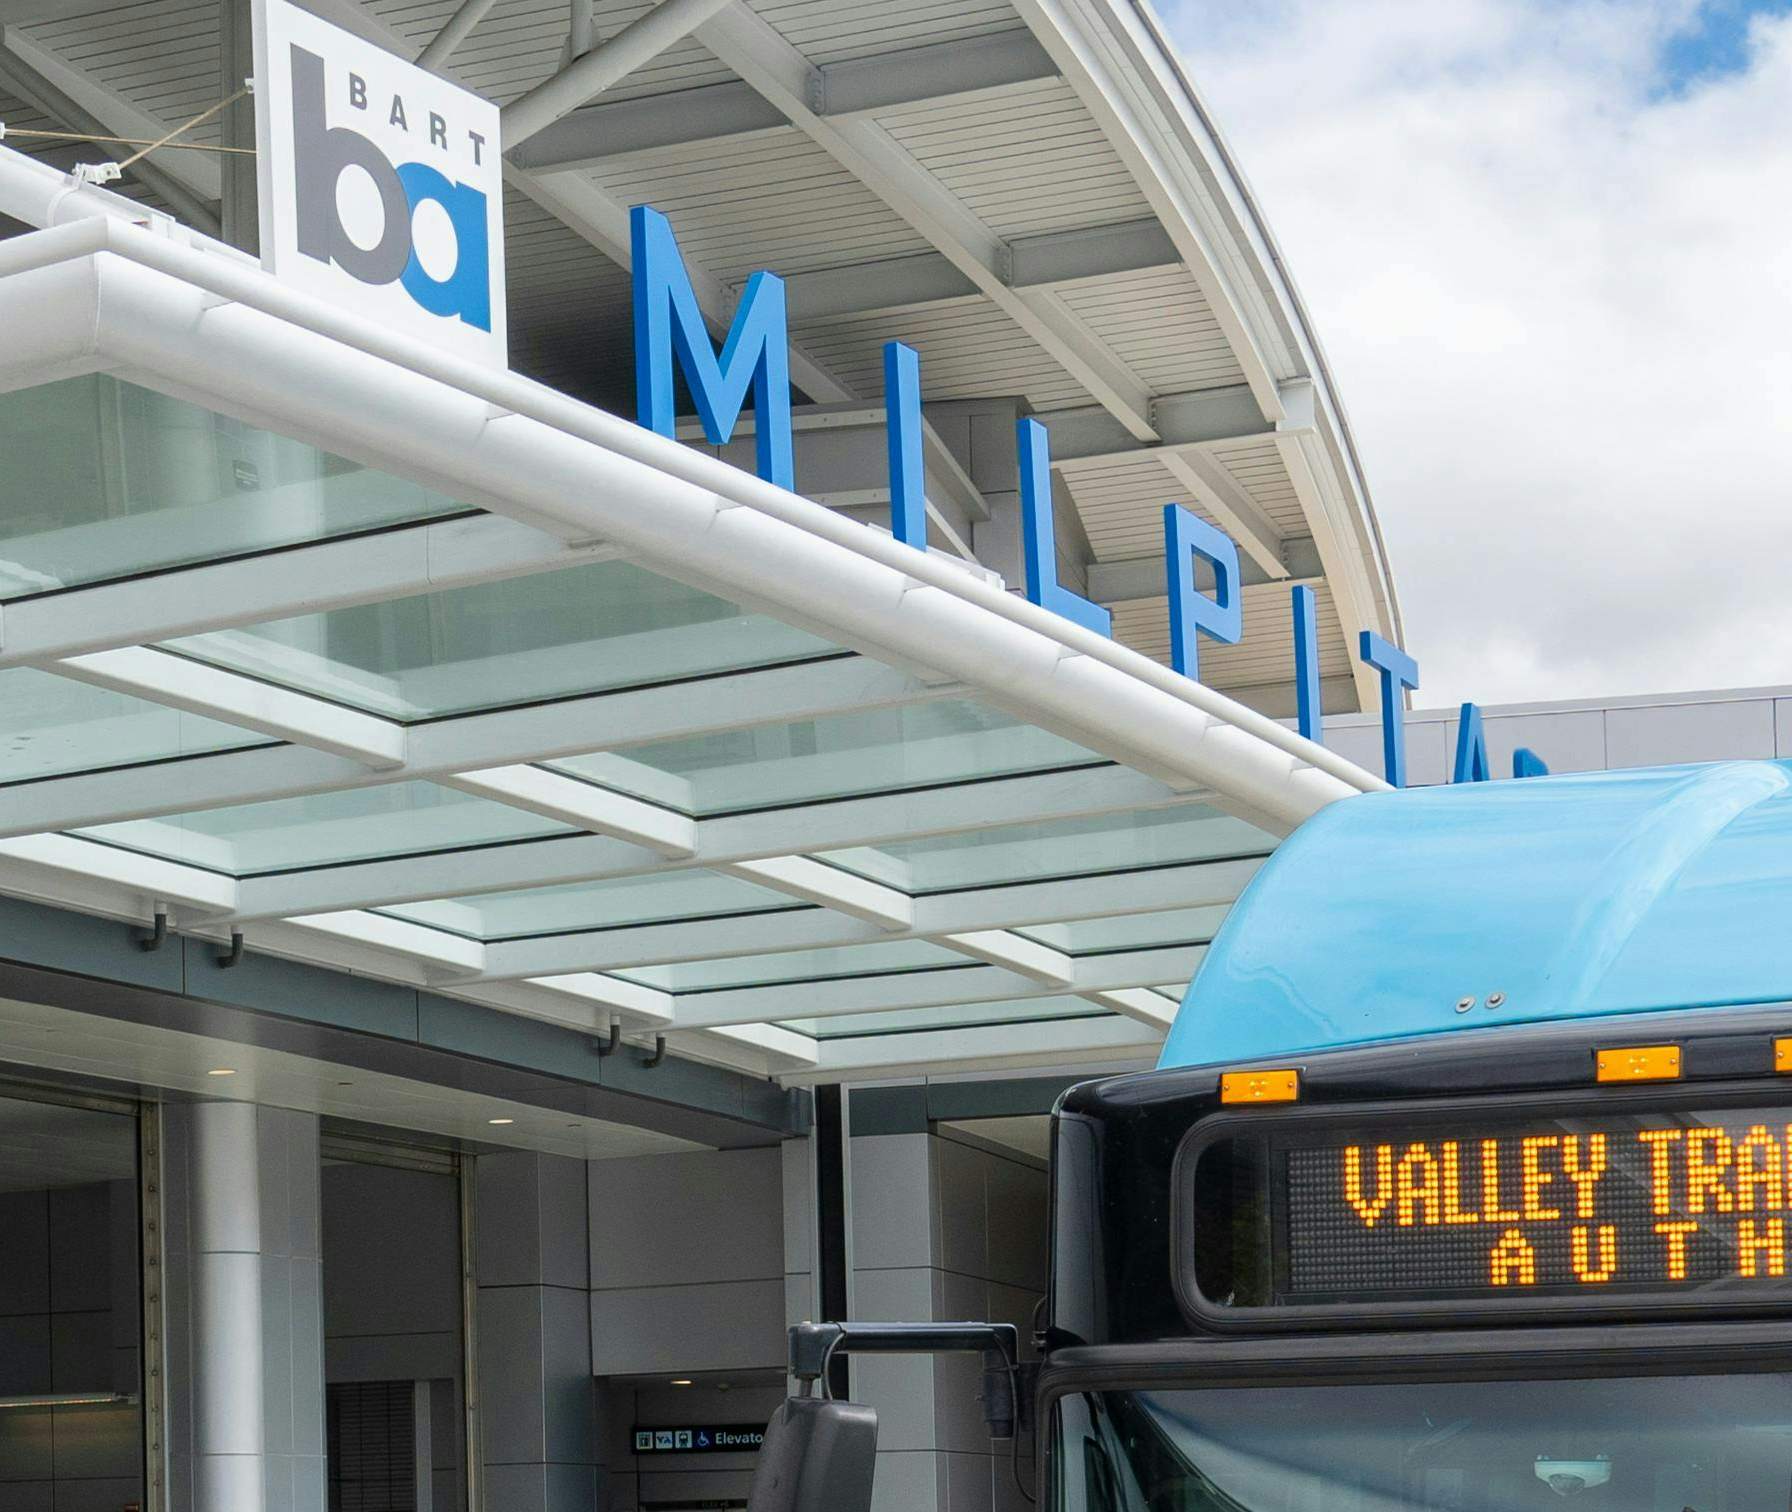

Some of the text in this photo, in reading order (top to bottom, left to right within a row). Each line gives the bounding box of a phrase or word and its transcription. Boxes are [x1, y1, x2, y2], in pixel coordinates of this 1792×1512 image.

[349, 71, 485, 167] BART
[630, 205, 1550, 787] MILPITA
[1344, 1132, 1606, 1228] VALLEY
[715, 1432, 764, 1444] Elevato
